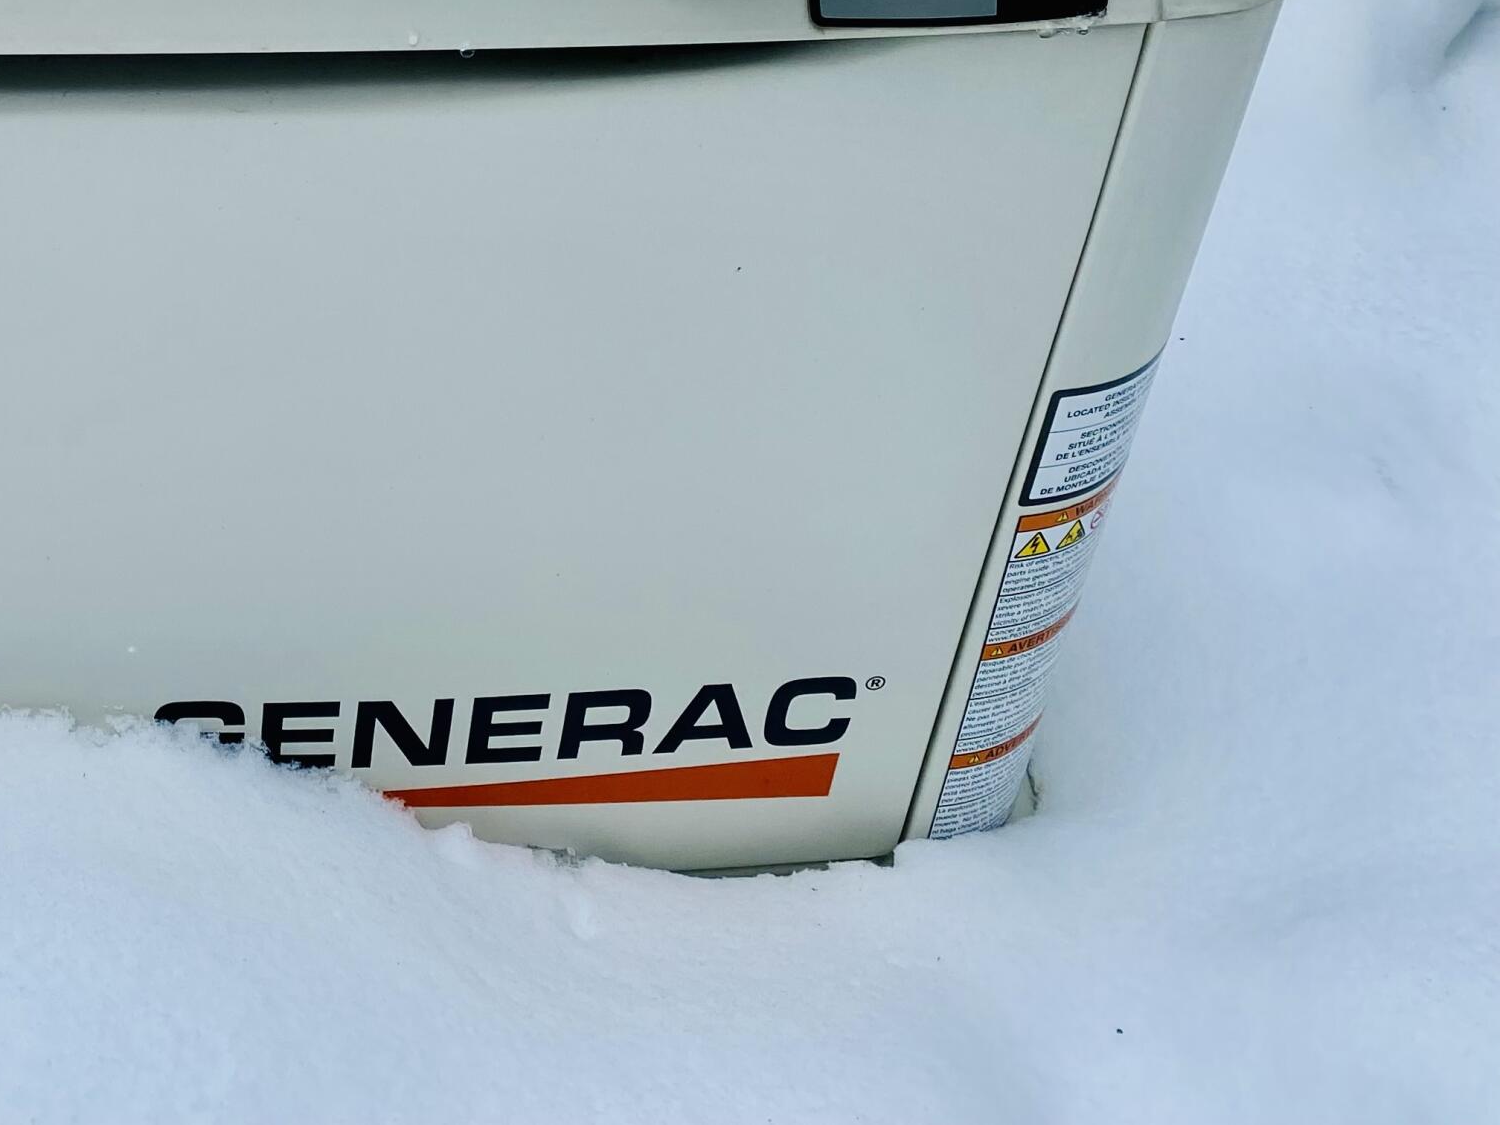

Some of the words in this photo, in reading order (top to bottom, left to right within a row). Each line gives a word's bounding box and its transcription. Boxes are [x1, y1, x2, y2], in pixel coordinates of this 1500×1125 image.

[1067, 402, 1110, 418] LOCATED
[1055, 452, 1069, 461] DE
[1064, 466, 1102, 483] UBICADA
[1040, 487, 1053, 495] DE
[1055, 476, 1097, 492] MONTAJE
